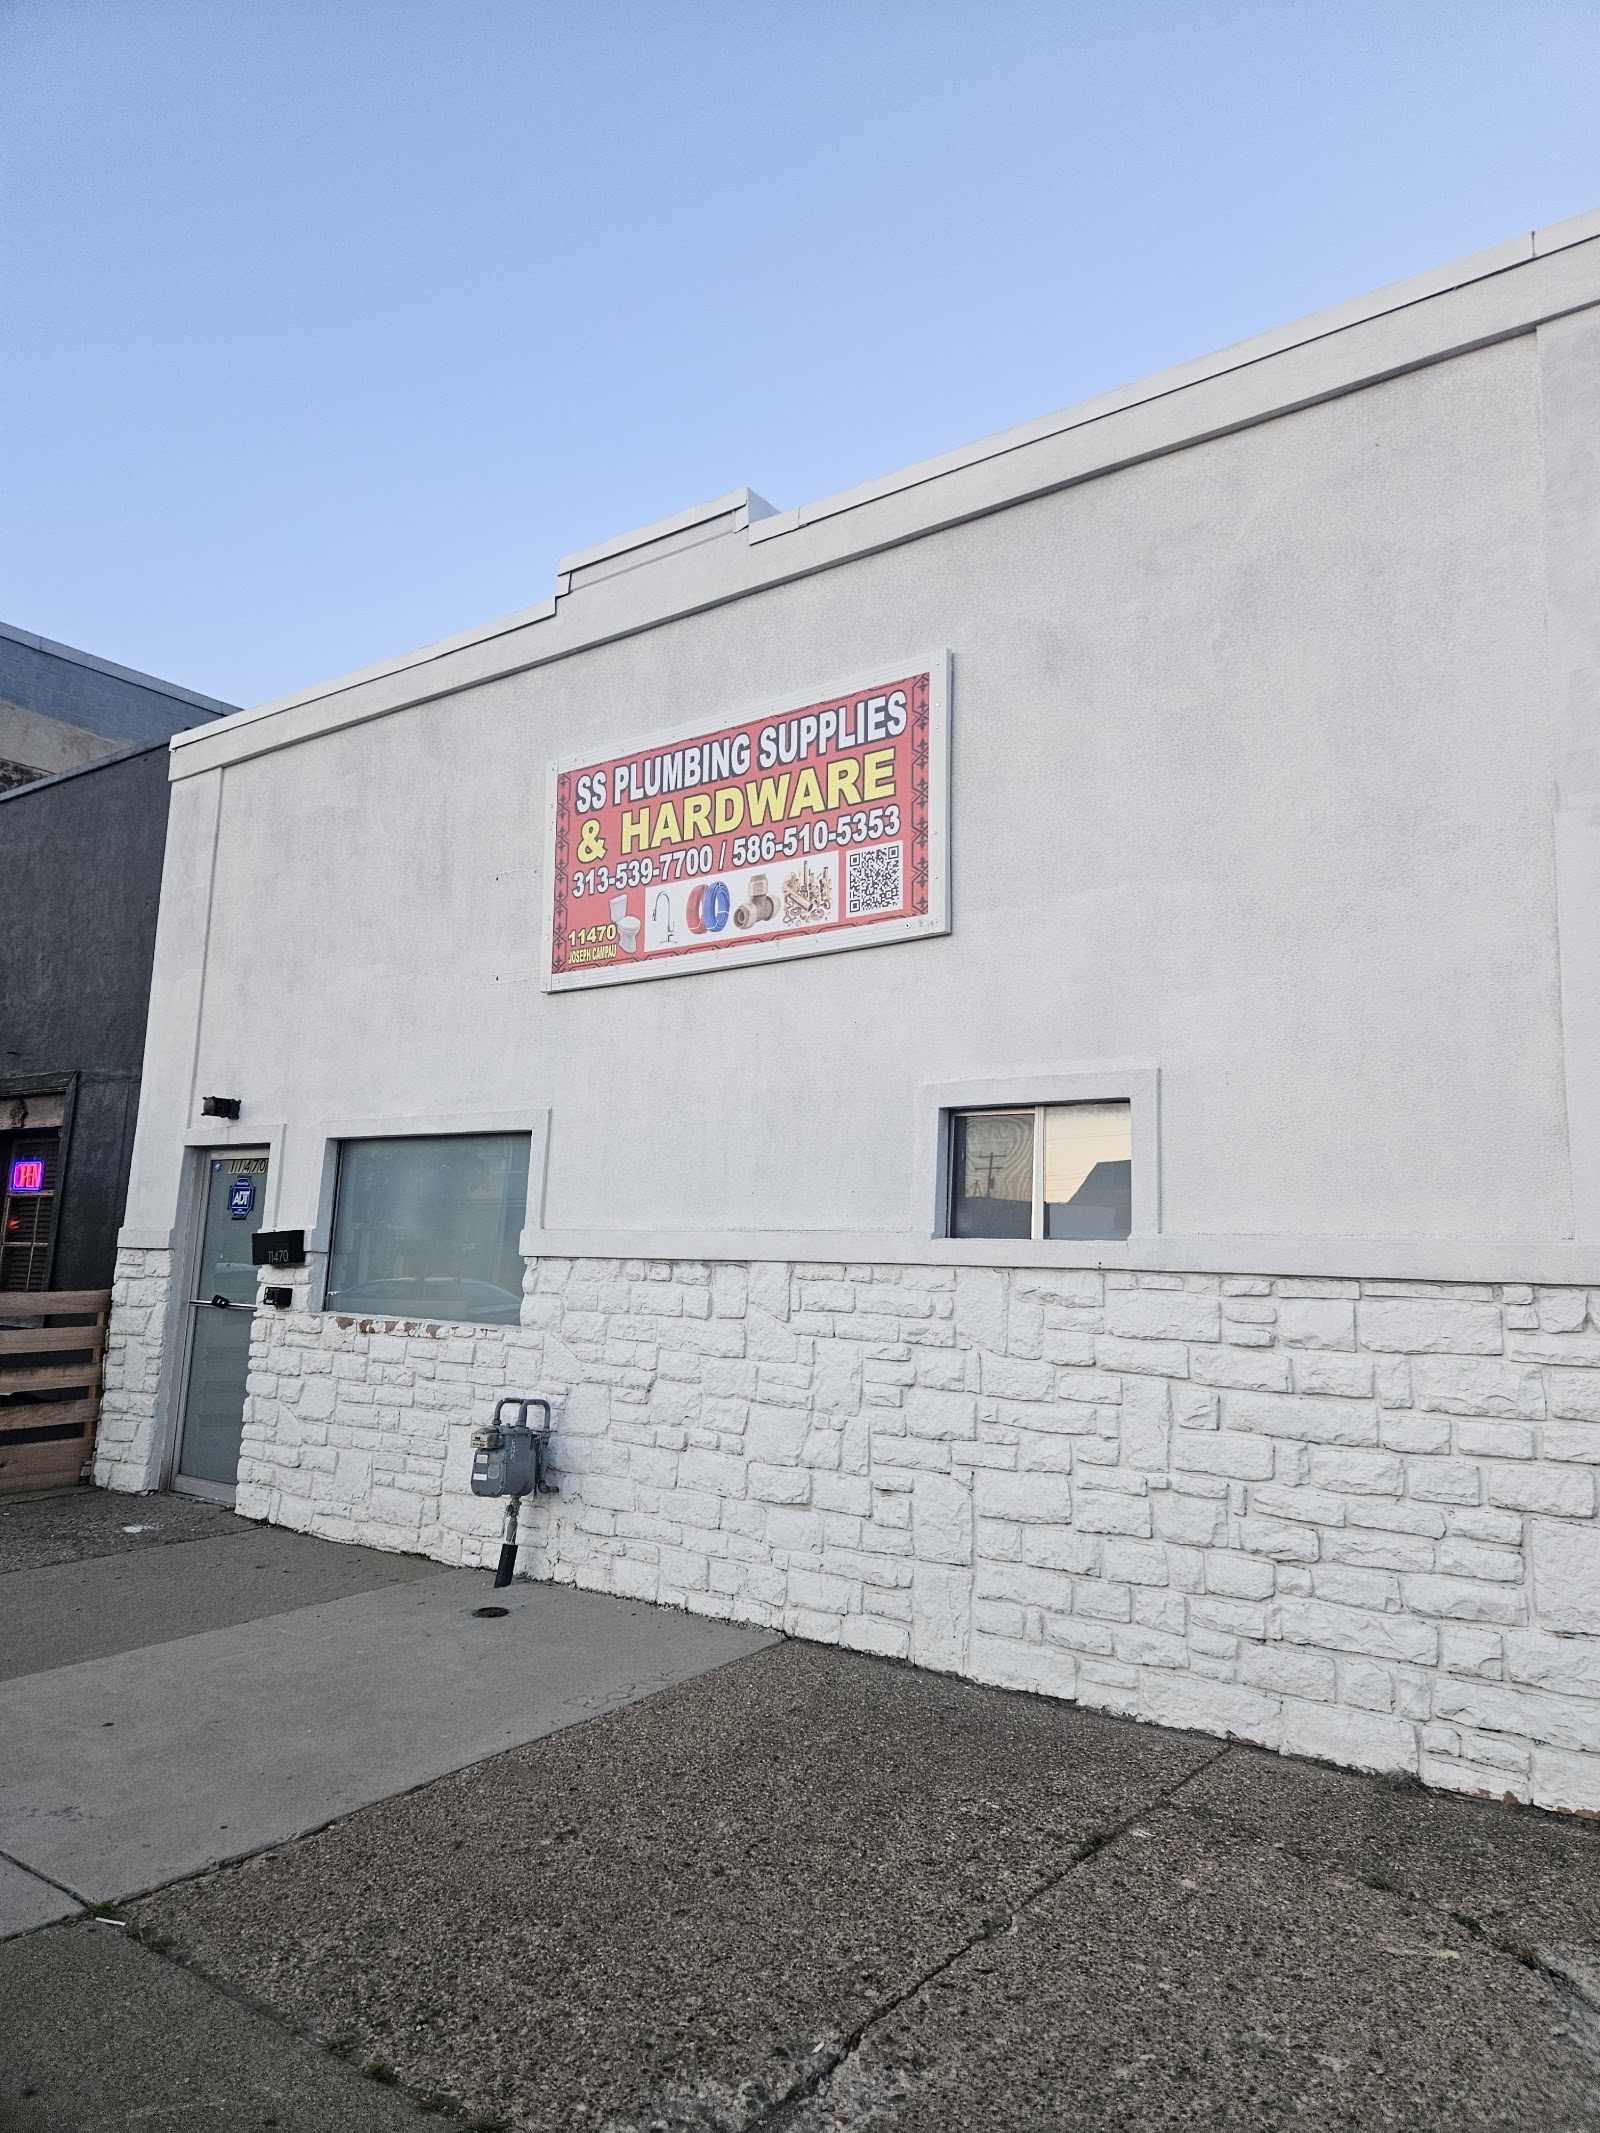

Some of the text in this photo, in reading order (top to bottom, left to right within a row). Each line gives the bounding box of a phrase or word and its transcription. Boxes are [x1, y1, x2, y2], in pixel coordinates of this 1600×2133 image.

[575, 691, 908, 814] SS PLUMBING SUPPLIES
[576, 747, 896, 863] & HARDWARE
[572, 845, 714, 898] 313-539-7700
[733, 804, 901, 866] 586-510-5353
[568, 923, 617, 947] 11470
[568, 944, 617, 964] JOSEPH CAMPAU
[229, 1159, 268, 1174] 11470
[232, 1190, 250, 1205] ADT
[267, 1249, 289, 1263] 11470
